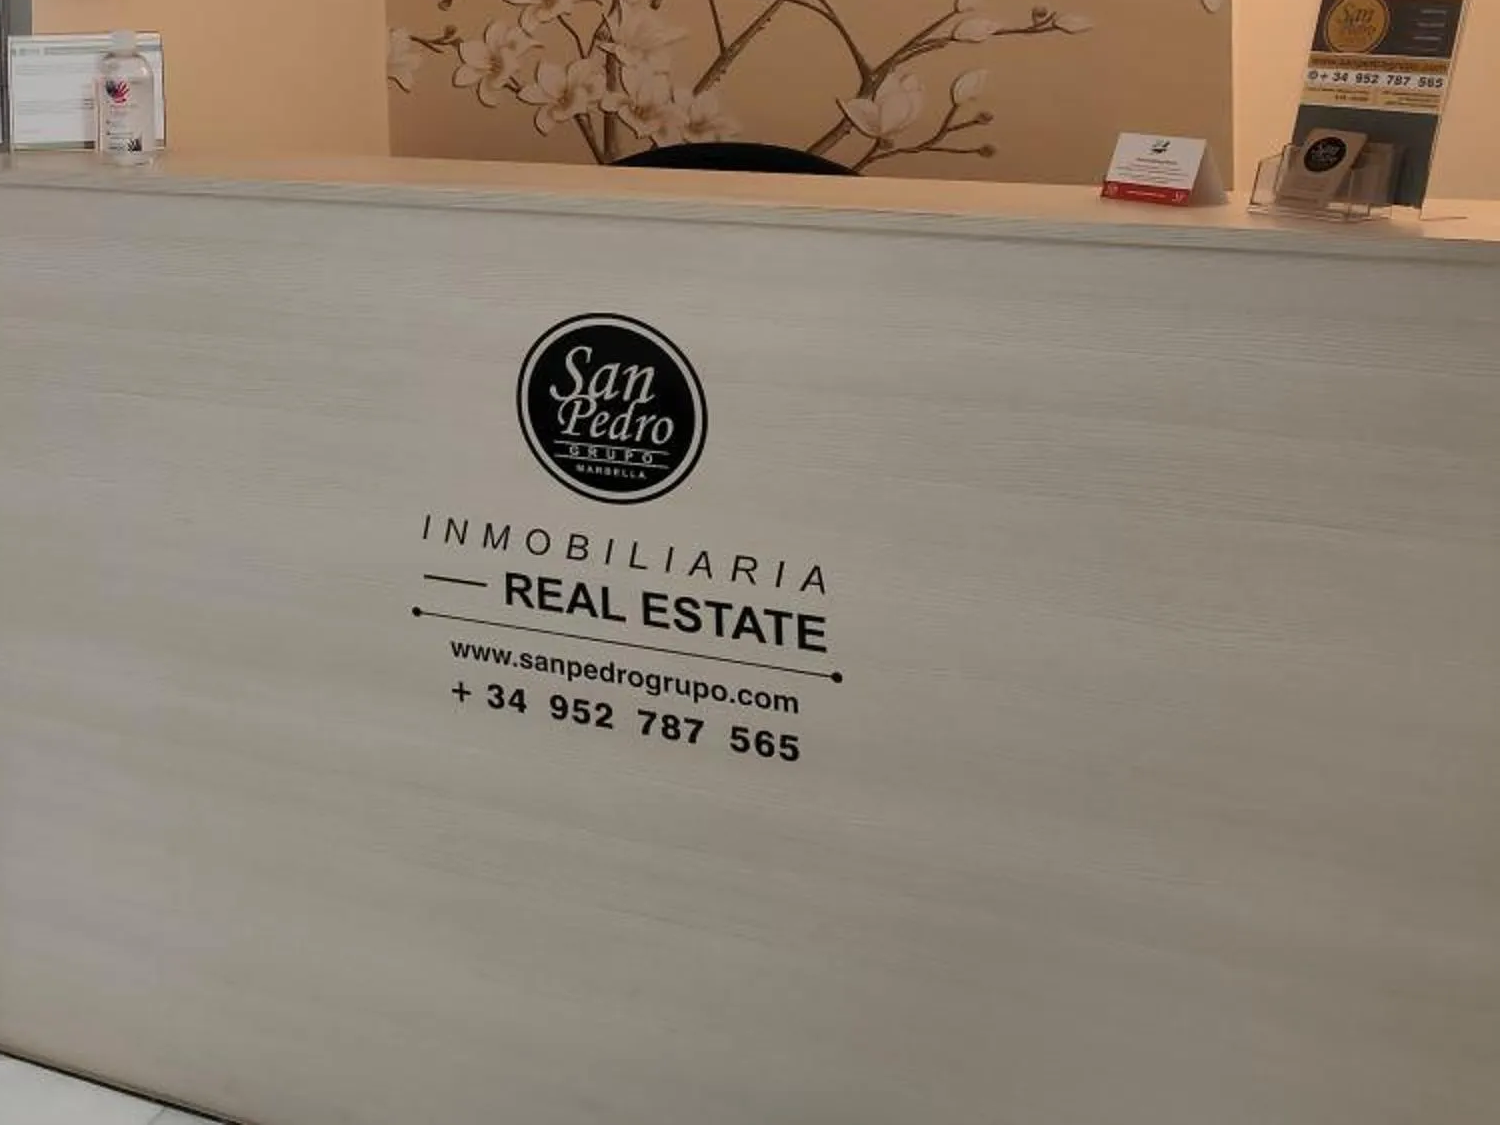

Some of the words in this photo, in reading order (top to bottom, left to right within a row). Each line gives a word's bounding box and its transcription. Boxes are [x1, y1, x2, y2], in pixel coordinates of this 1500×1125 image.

[1332, 72, 1349, 83] 34
[1355, 73, 1380, 84] 952
[1387, 74, 1411, 86] 787
[550, 346, 656, 404] San
[557, 394, 675, 446] Pedro
[568, 444, 654, 464] GRUPO
[575, 463, 648, 480] MARBELLA
[422, 514, 826, 595] INMOBILIARIA
[505, 572, 627, 623] REAL
[642, 591, 828, 653] ESTATE
[450, 640, 799, 714] www.sanpedrogrupo.com
[451, 680, 472, 703] +
[486, 683, 528, 714] 34
[549, 694, 614, 730] 952
[637, 708, 705, 744] 787
[729, 725, 801, 762] 565
